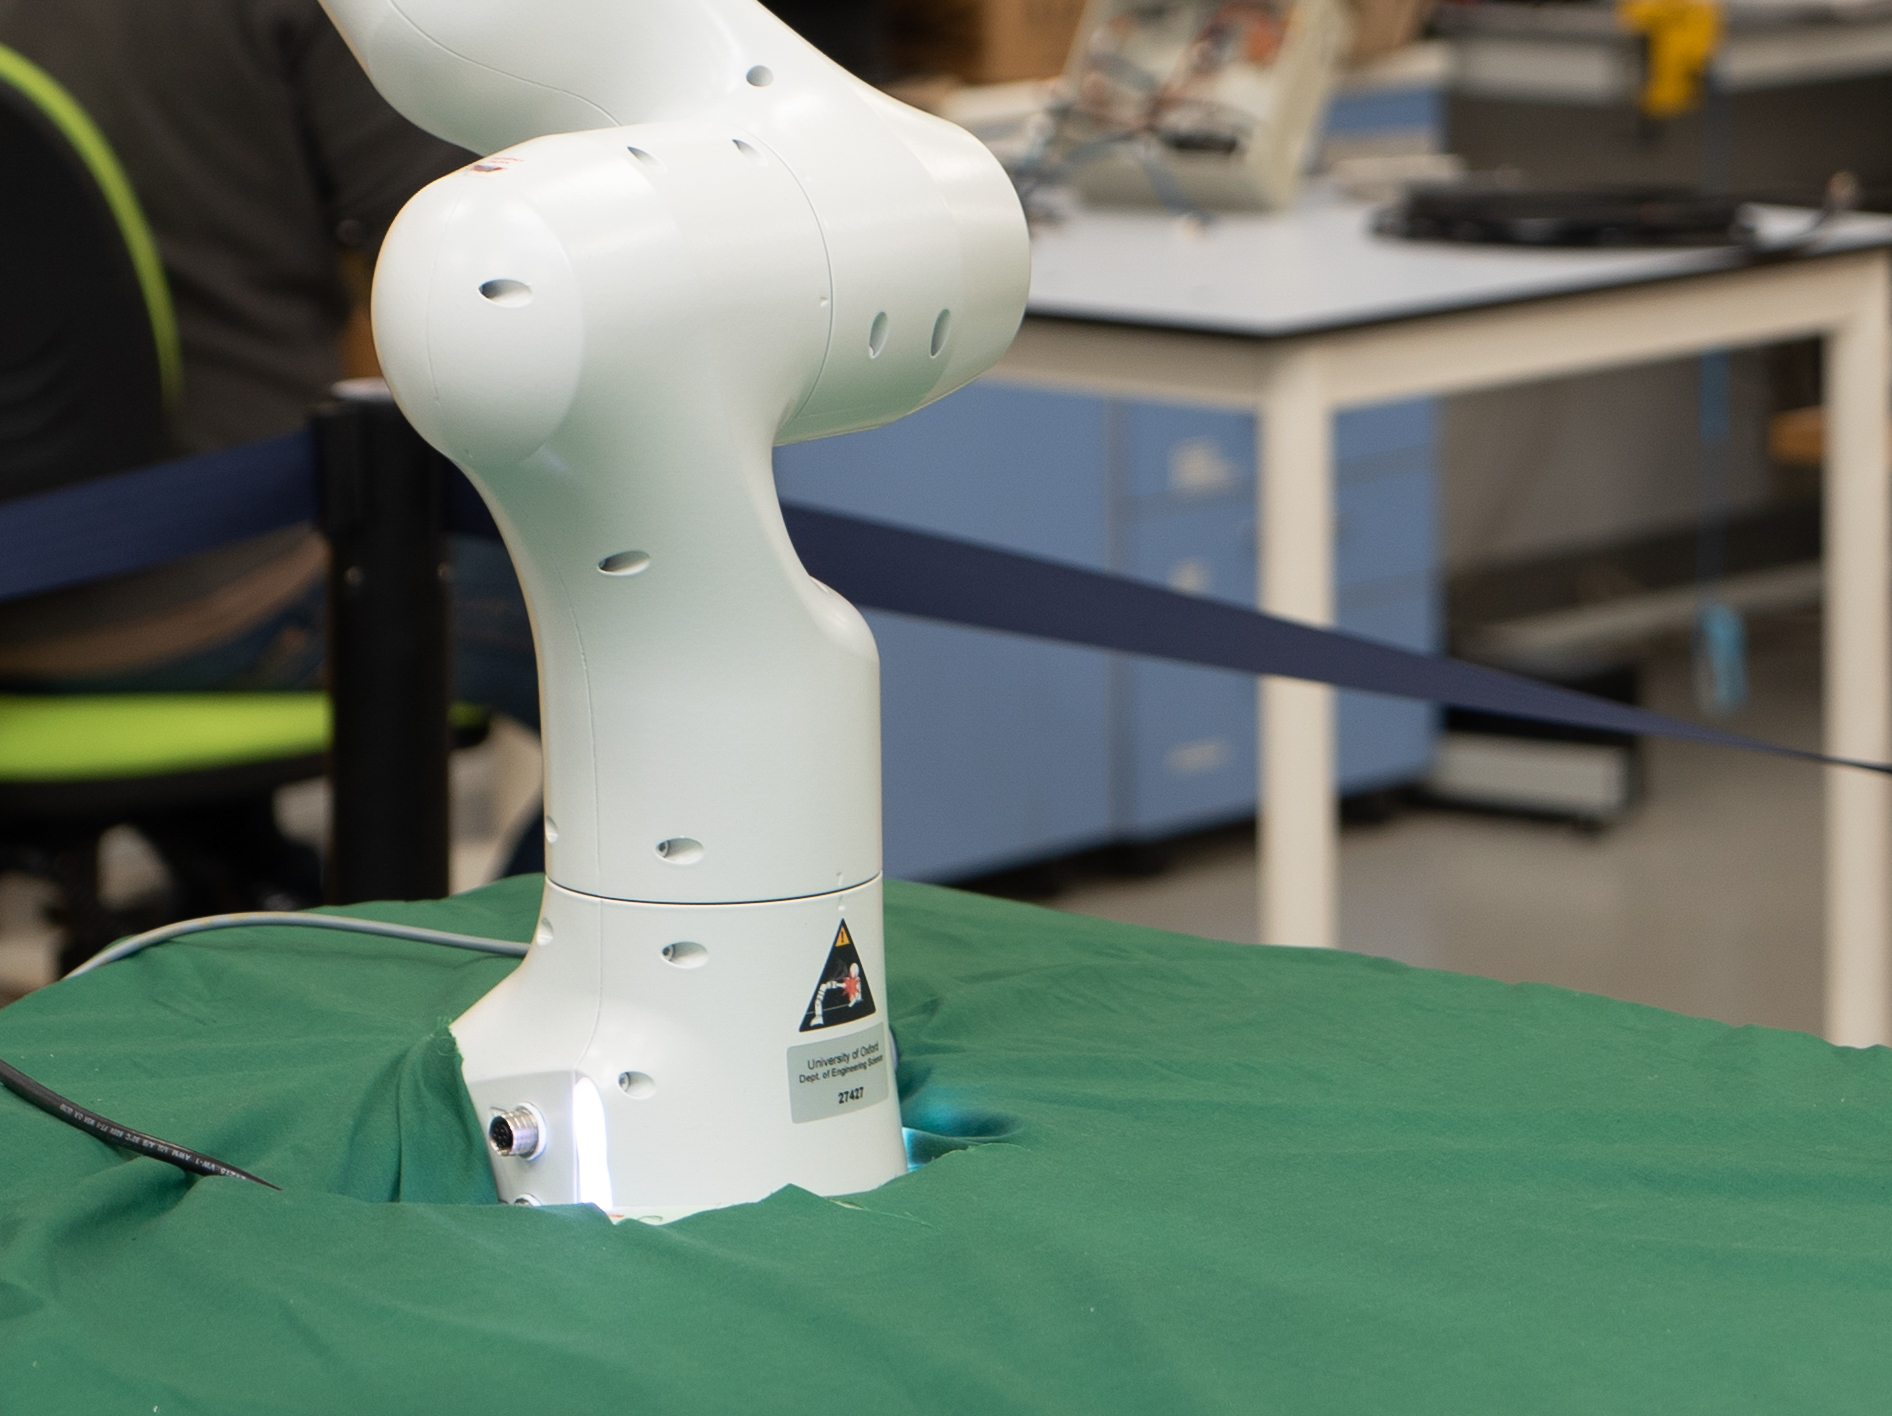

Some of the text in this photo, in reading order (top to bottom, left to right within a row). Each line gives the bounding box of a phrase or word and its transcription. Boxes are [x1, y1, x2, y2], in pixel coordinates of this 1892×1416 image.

[807, 1041, 879, 1070] University of Oxford
[799, 1073, 820, 1084] Dept.
[822, 1069, 830, 1079] of
[831, 1061, 868, 1077] Engineering
[838, 1086, 864, 1104] 27427
